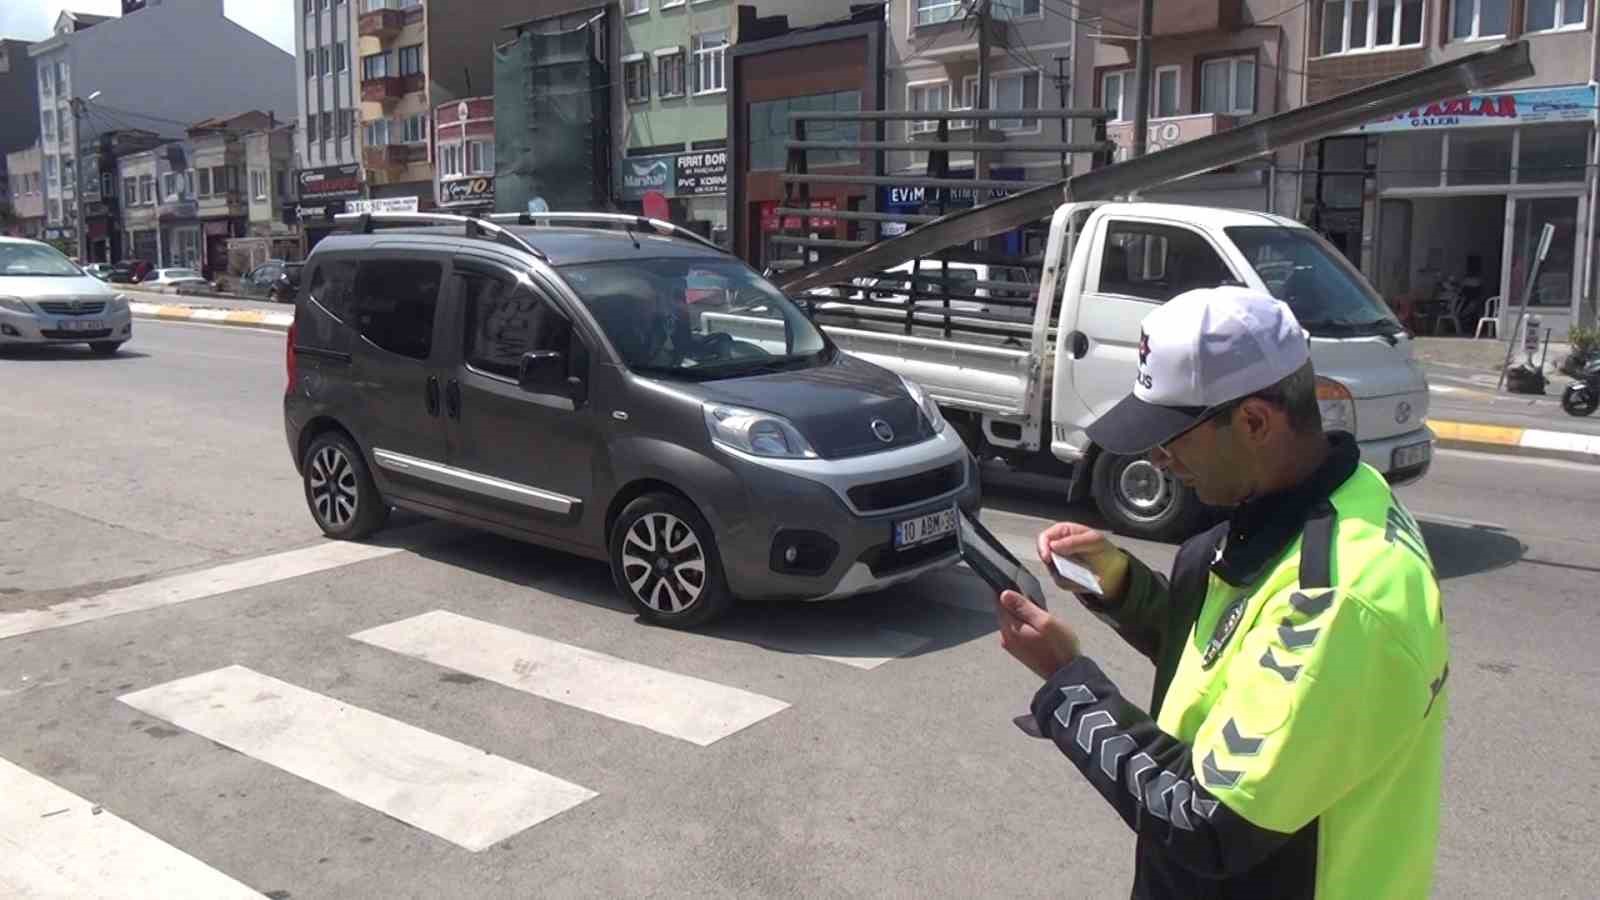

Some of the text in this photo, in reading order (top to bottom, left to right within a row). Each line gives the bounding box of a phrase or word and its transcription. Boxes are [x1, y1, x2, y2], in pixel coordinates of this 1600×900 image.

[705, 152, 728, 166] BOR
[678, 178, 696, 187] PVC
[904, 521, 915, 541] 10
